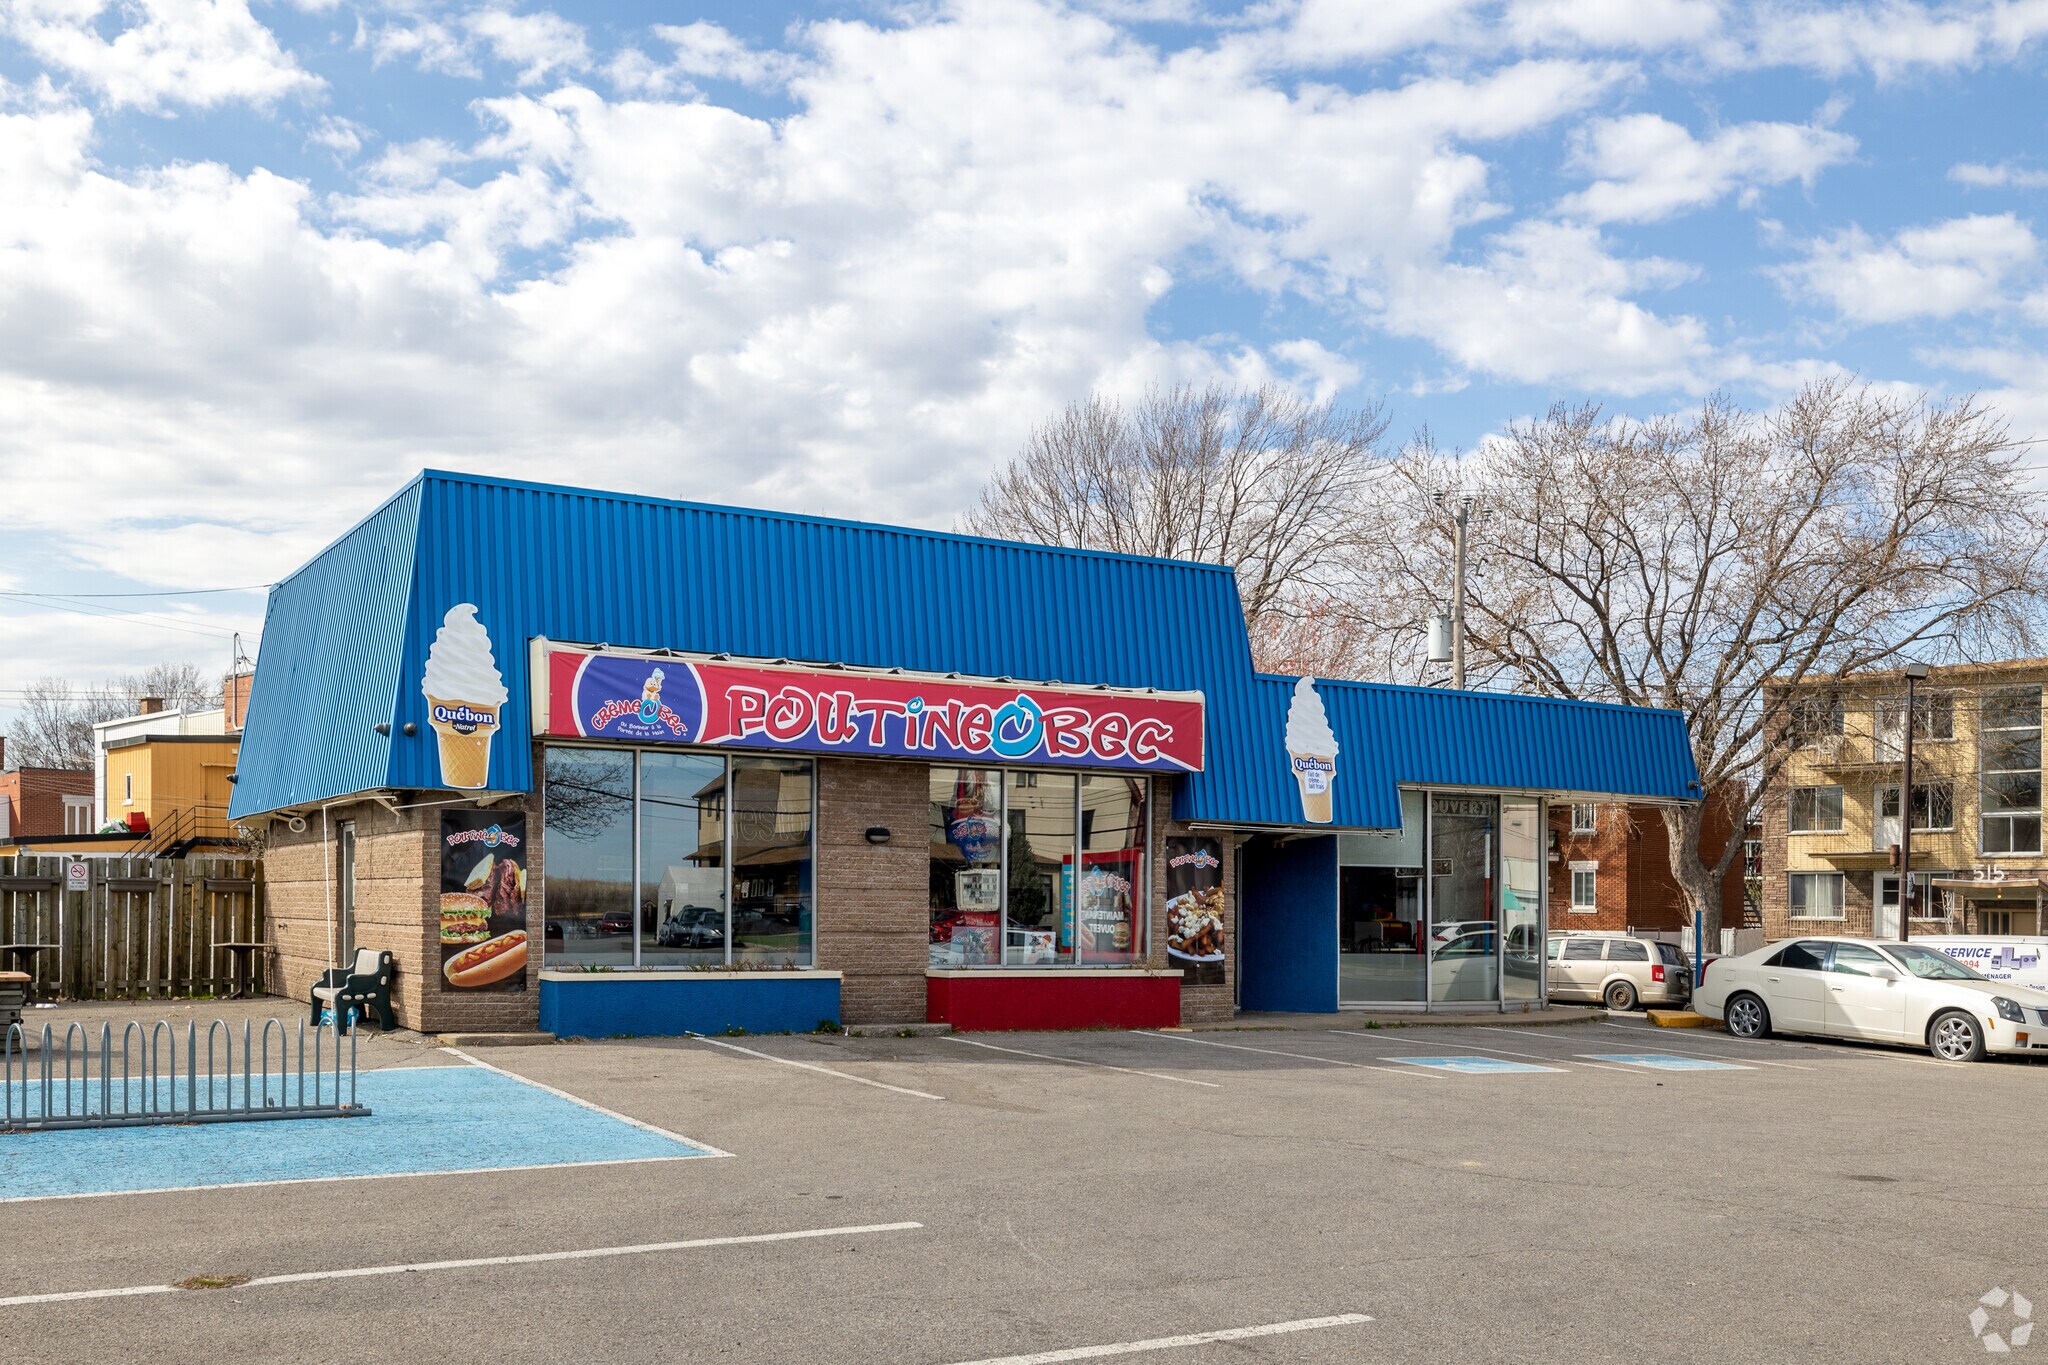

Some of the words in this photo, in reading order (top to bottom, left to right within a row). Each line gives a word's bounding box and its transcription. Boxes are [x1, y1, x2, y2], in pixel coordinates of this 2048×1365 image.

[433, 703, 495, 724] Québon
[1294, 757, 1332, 771] Québon
[1973, 864, 2005, 881] 515
[1944, 948, 1992, 958] SERVICE
